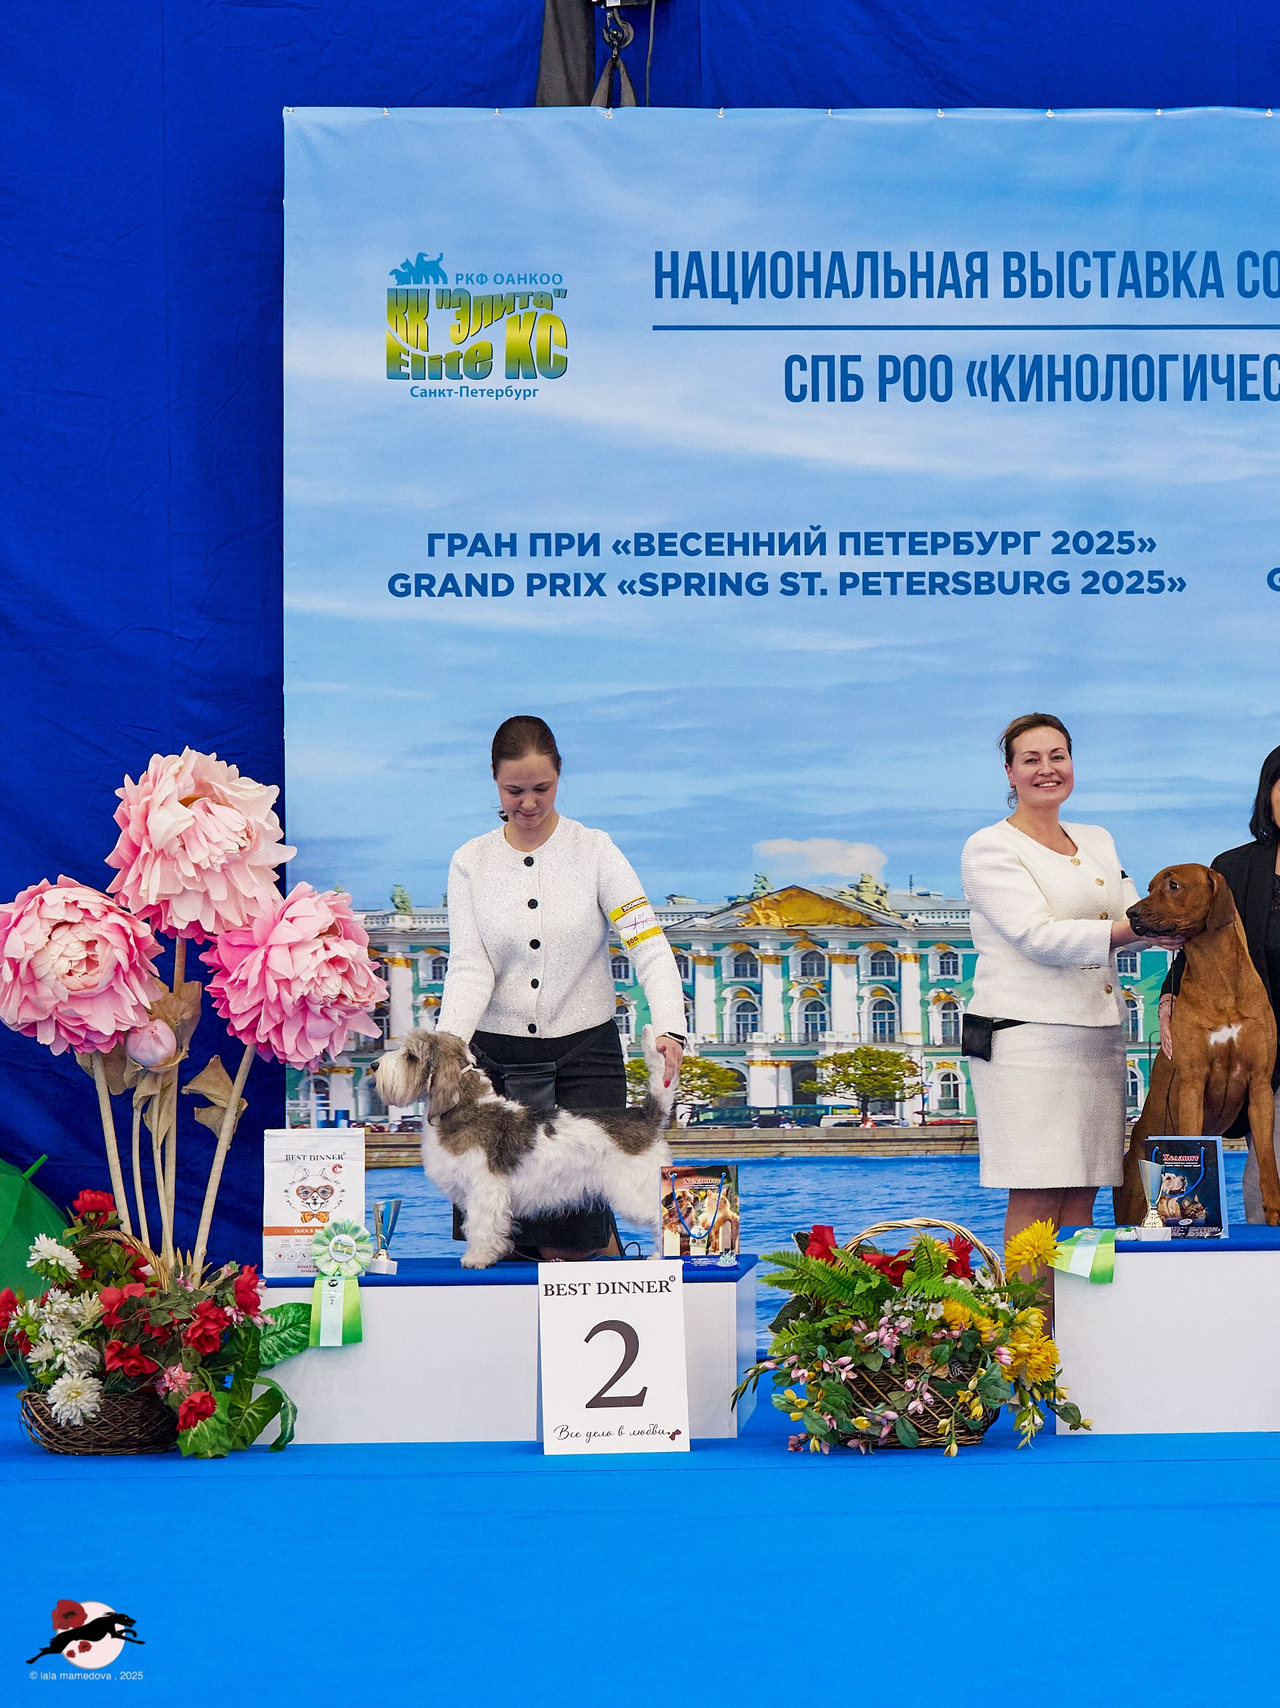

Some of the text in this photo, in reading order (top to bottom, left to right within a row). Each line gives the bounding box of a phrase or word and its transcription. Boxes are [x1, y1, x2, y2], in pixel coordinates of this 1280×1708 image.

[455, 272, 563, 286] РКФ ОАНКОО
[655, 251, 988, 304] НАЦИОНАЛЬНАЯ
[1003, 251, 1224, 298] ВЫСТАВКА
[386, 329, 493, 380] Elite
[785, 355, 863, 402] СПБ
[879, 354, 953, 402] РОО
[409, 385, 539, 401] Санкт-Петербург
[428, 525, 1156, 557] ГРАН ПРИ «ВЕСЕННИЙ ПЕТЕРБУРГ 2025»
[388, 570, 1186, 597] GRAND PRIX «SPRING ST. PETERSBURG 2025»
[543, 1282, 591, 1297] BEST
[584, 1319, 648, 1408] 2
[554, 1424, 581, 1441] Все
[584, 1429, 614, 1443] дело
[618, 1425, 625, 1437] в
